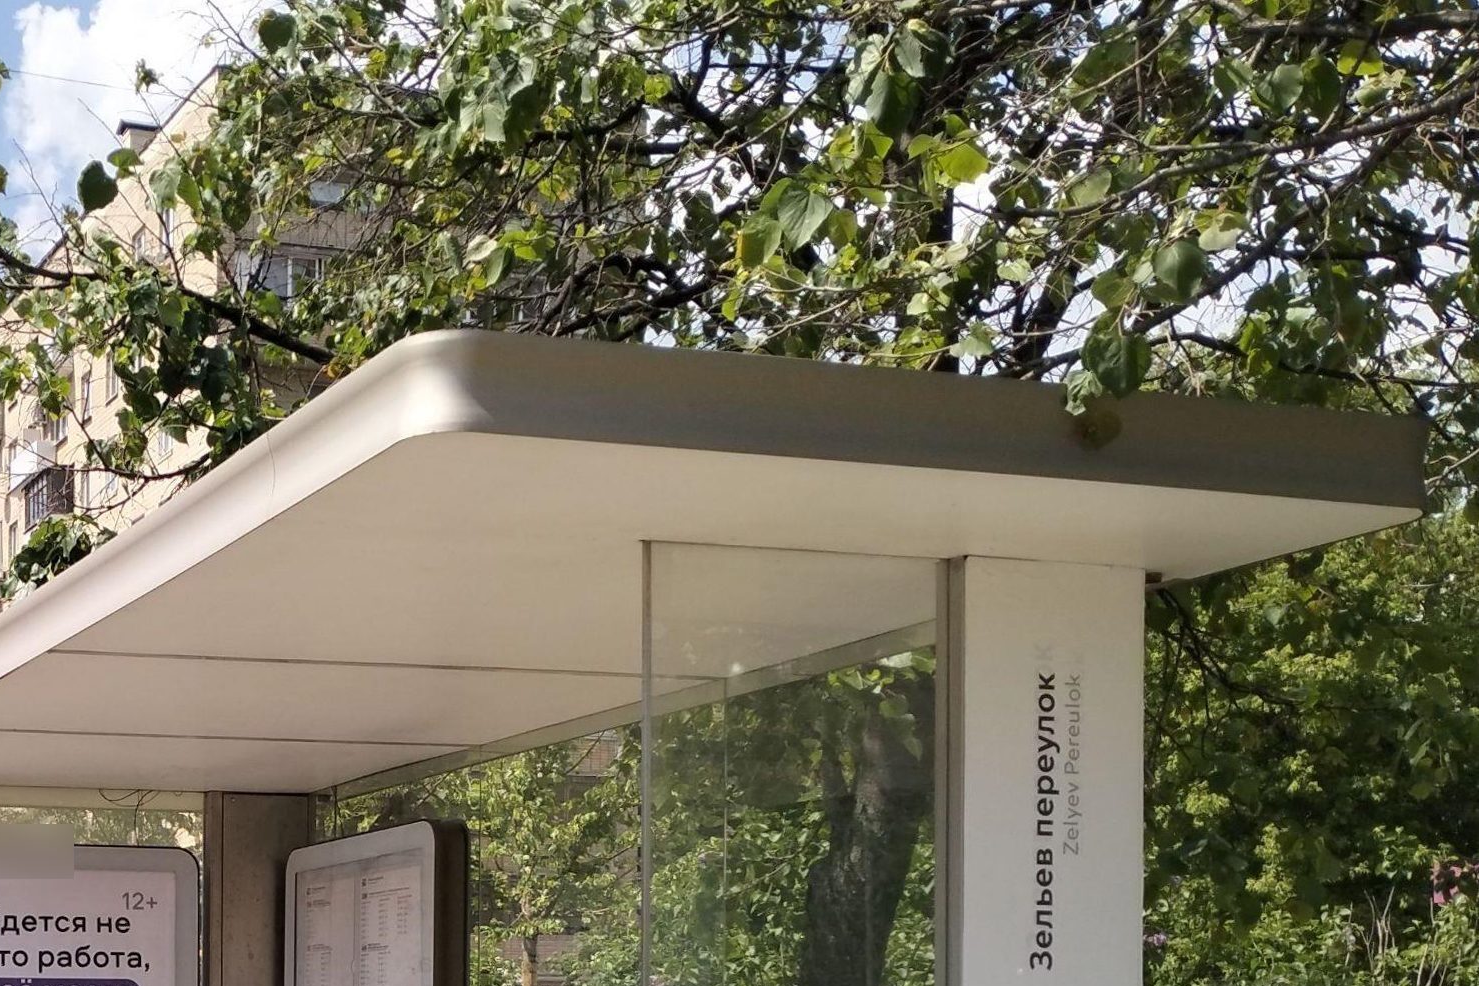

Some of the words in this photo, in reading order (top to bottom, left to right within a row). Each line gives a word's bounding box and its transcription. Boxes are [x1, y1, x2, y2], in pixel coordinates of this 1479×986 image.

[1035, 672, 1060, 836] переулок
[1064, 673, 1081, 775] Pereulok
[1062, 780, 1082, 855] Zelyev
[96, 916, 131, 934] не
[121, 892, 158, 910] 12+
[1029, 847, 1054, 970] Зельев
[38, 945, 150, 973] работа,
